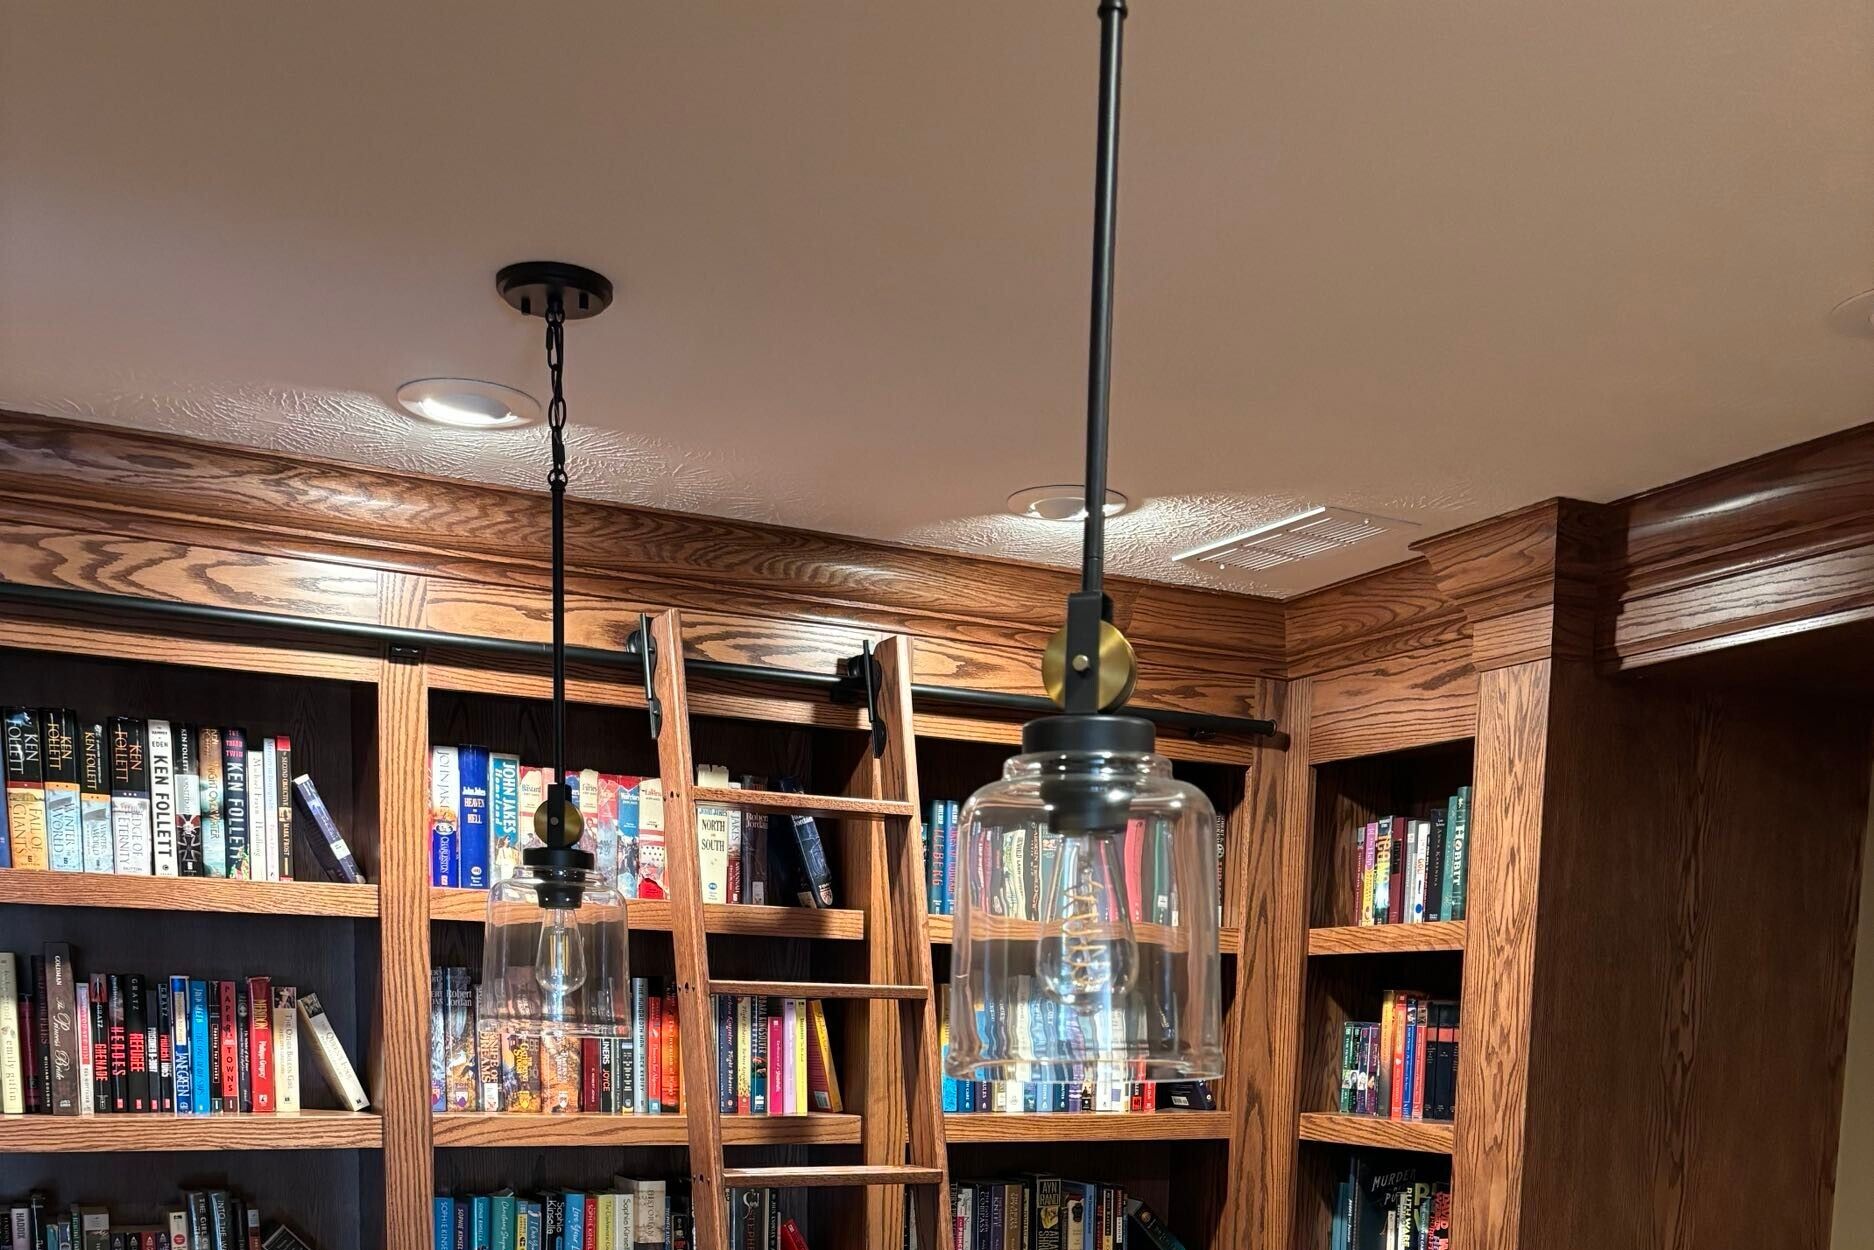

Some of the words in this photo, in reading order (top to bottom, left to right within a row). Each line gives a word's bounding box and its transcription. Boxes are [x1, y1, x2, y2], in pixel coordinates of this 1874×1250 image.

[24, 734, 38, 761] KEN
[48, 723, 61, 770] FOLLETT
[60, 736, 72, 759] KEN
[85, 732, 96, 752] KEN
[115, 731, 128, 782] FOLLETT
[129, 744, 142, 770] KEN
[86, 753, 97, 790] FOLLETT
[154, 755, 169, 785] KEN
[502, 762, 516, 796] JOHN
[494, 768, 502, 825] Homeland
[13, 804, 26, 855] GIANTS
[52, 809, 63, 853] WORLD
[65, 803, 75, 846] WINTER
[156, 793, 172, 857] FOLLETT
[503, 798, 516, 834] JAKES
[701, 819, 726, 832] NORTH
[731, 814, 739, 841] JAKES
[118, 817, 130, 865] ETERNITY
[440, 836, 450, 873] CHARLESTON
[701, 839, 726, 852] SOUTH
[932, 829, 944, 886] ICEBERG
[1452, 825, 1465, 886] HOBBIT
[254, 1000, 268, 1029] MERIDON
[111, 1026, 125, 1076] HEROES
[129, 1033, 144, 1072] REFUGEE
[489, 1032, 498, 1067] KNIFE
[759, 1017, 767, 1054] KINGSOLVER
[5, 1040, 16, 1069] emily
[95, 1043, 107, 1081] GRENADE
[481, 1032, 490, 1083] DREAMS
[491, 1069, 498, 1082] OF
[602, 1069, 610, 1092] JOYCE
[1041, 1184, 1058, 1193] AYN
[16, 1213, 26, 1239] HADDIX
[217, 1200, 225, 1220] INTO
[547, 1200, 556, 1235] Kinsella
[556, 1202, 564, 1233] Sophie
[1440, 1194, 1451, 1229] DAVID
[1403, 1218, 1411, 1248] WARE
